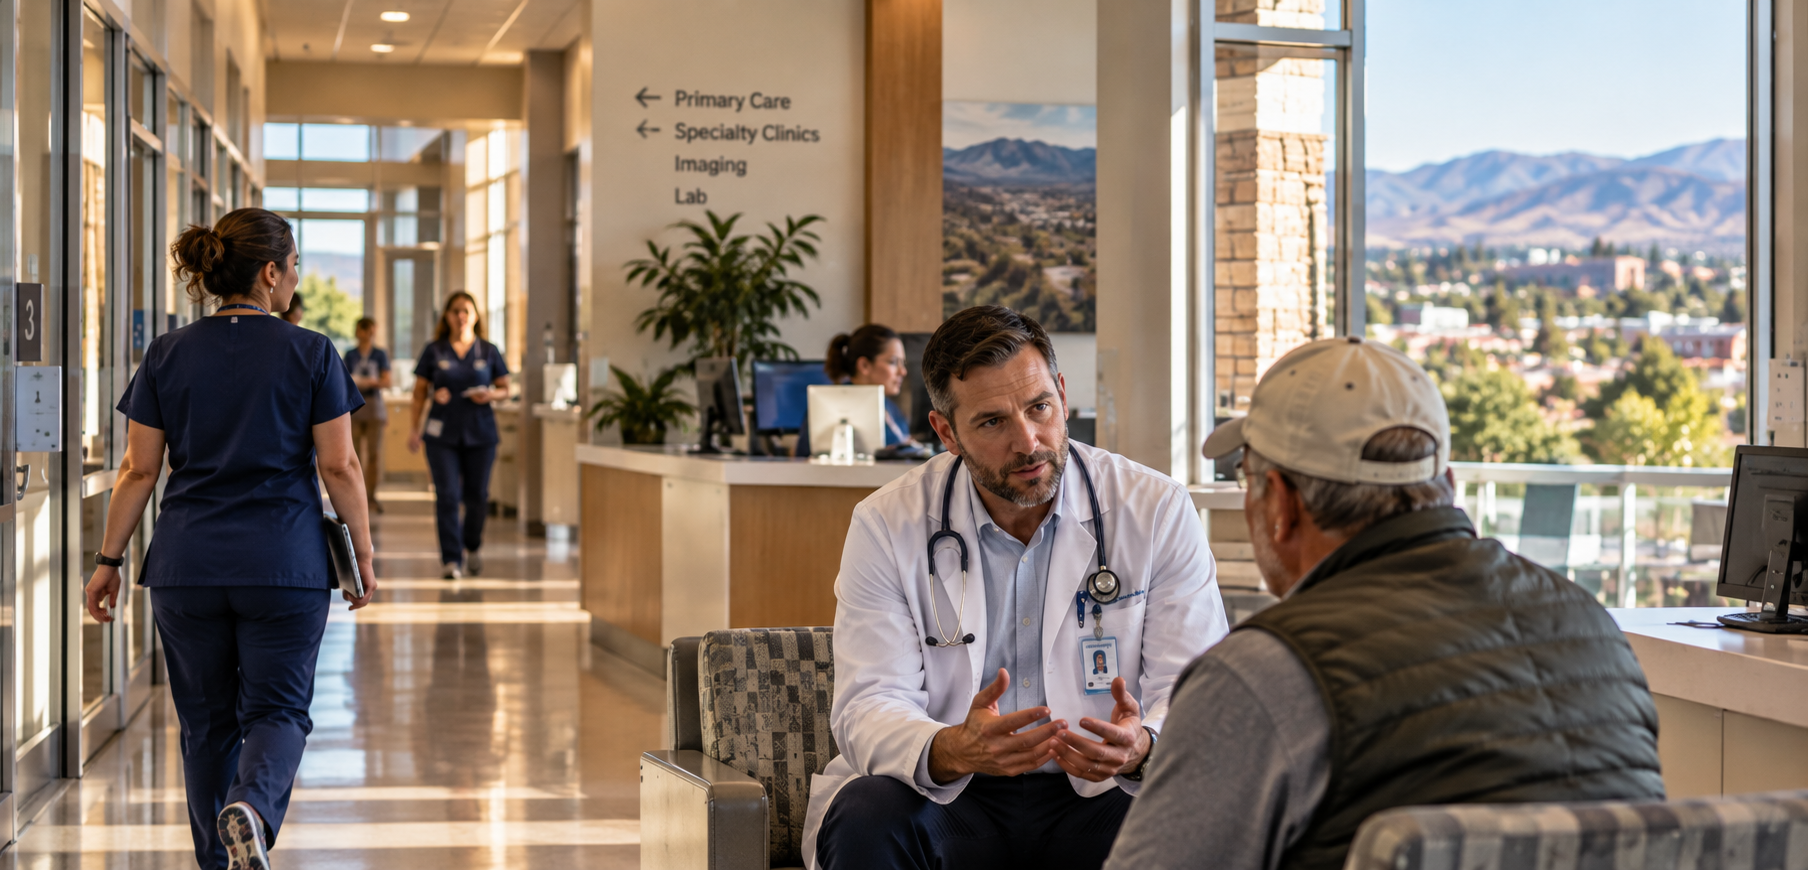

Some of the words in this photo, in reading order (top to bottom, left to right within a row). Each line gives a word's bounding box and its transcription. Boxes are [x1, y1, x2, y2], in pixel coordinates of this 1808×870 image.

[674, 89, 745, 113] Primary
[750, 91, 792, 110] Care
[674, 121, 758, 145] Specialty
[762, 124, 821, 143] Clinics
[674, 154, 748, 178] Imaging
[674, 187, 708, 205] Lab
[24, 299, 35, 341] 3
